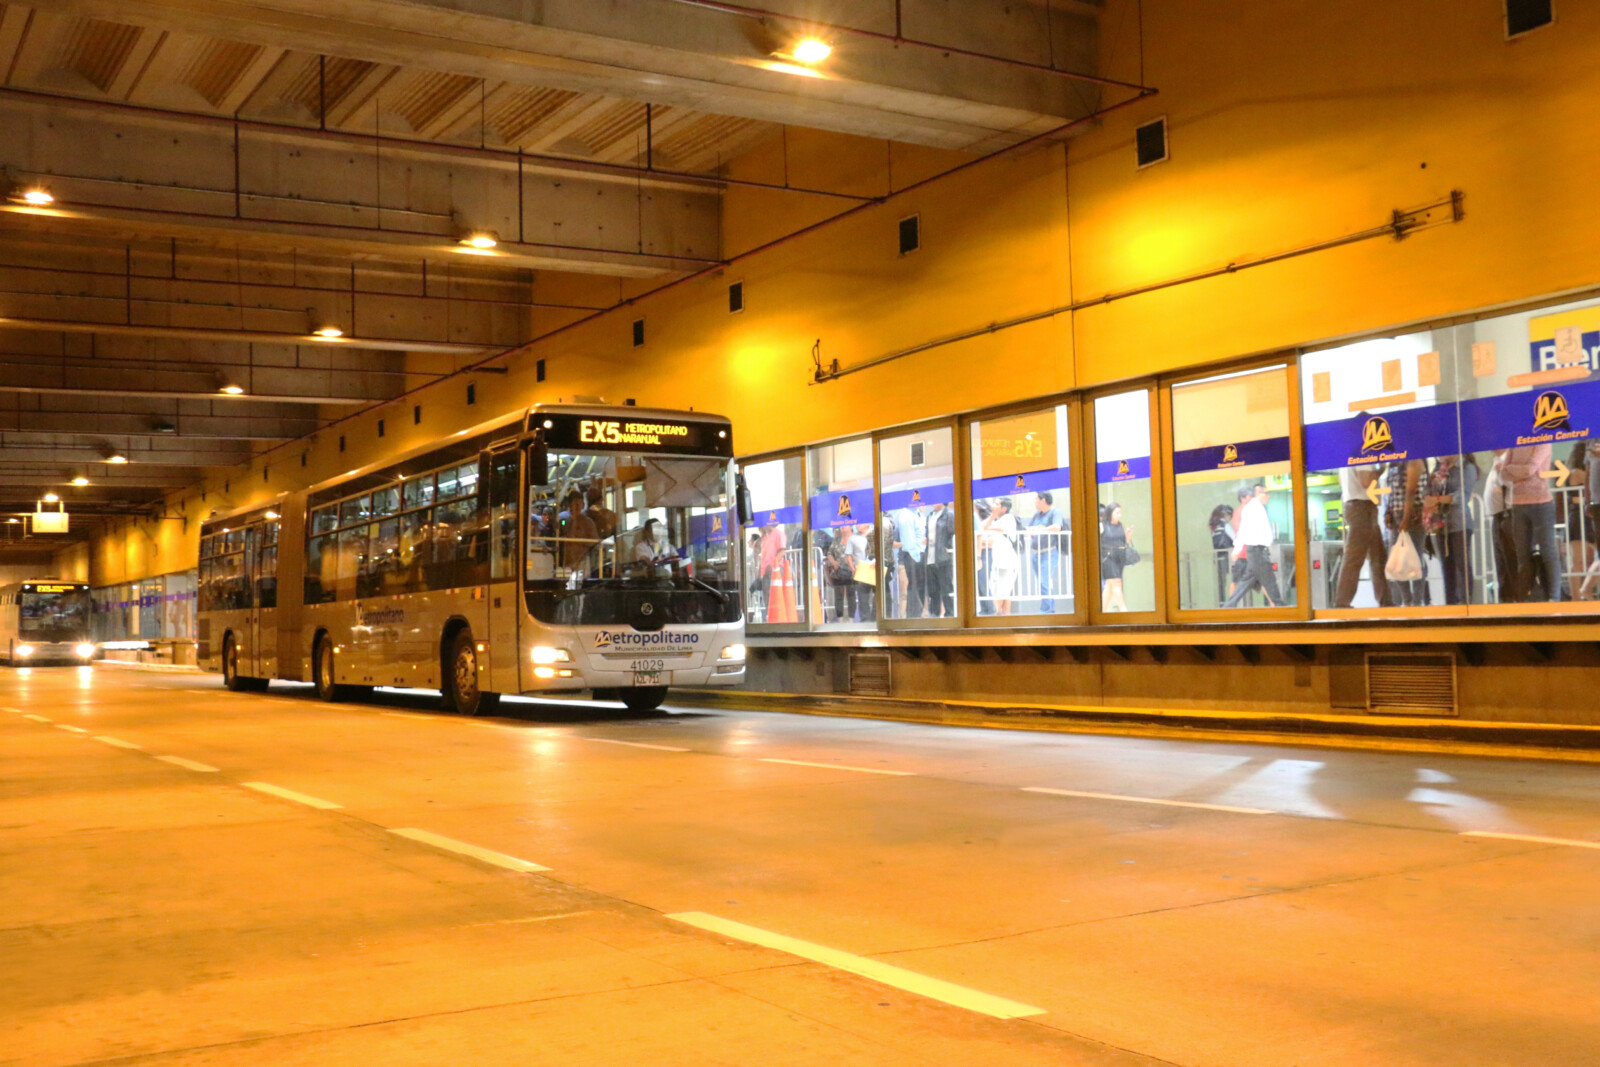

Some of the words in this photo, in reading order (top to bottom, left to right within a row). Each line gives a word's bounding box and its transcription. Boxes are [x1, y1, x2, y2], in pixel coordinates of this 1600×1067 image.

[580, 420, 620, 444] EX5
[625, 423, 688, 436] METROPOLITANO
[619, 433, 661, 445] NARANJAL
[1516, 433, 1553, 445] Estación
[1555, 427, 1589, 440] Central
[1379, 450, 1407, 461] Central
[630, 659, 664, 671] 41029
